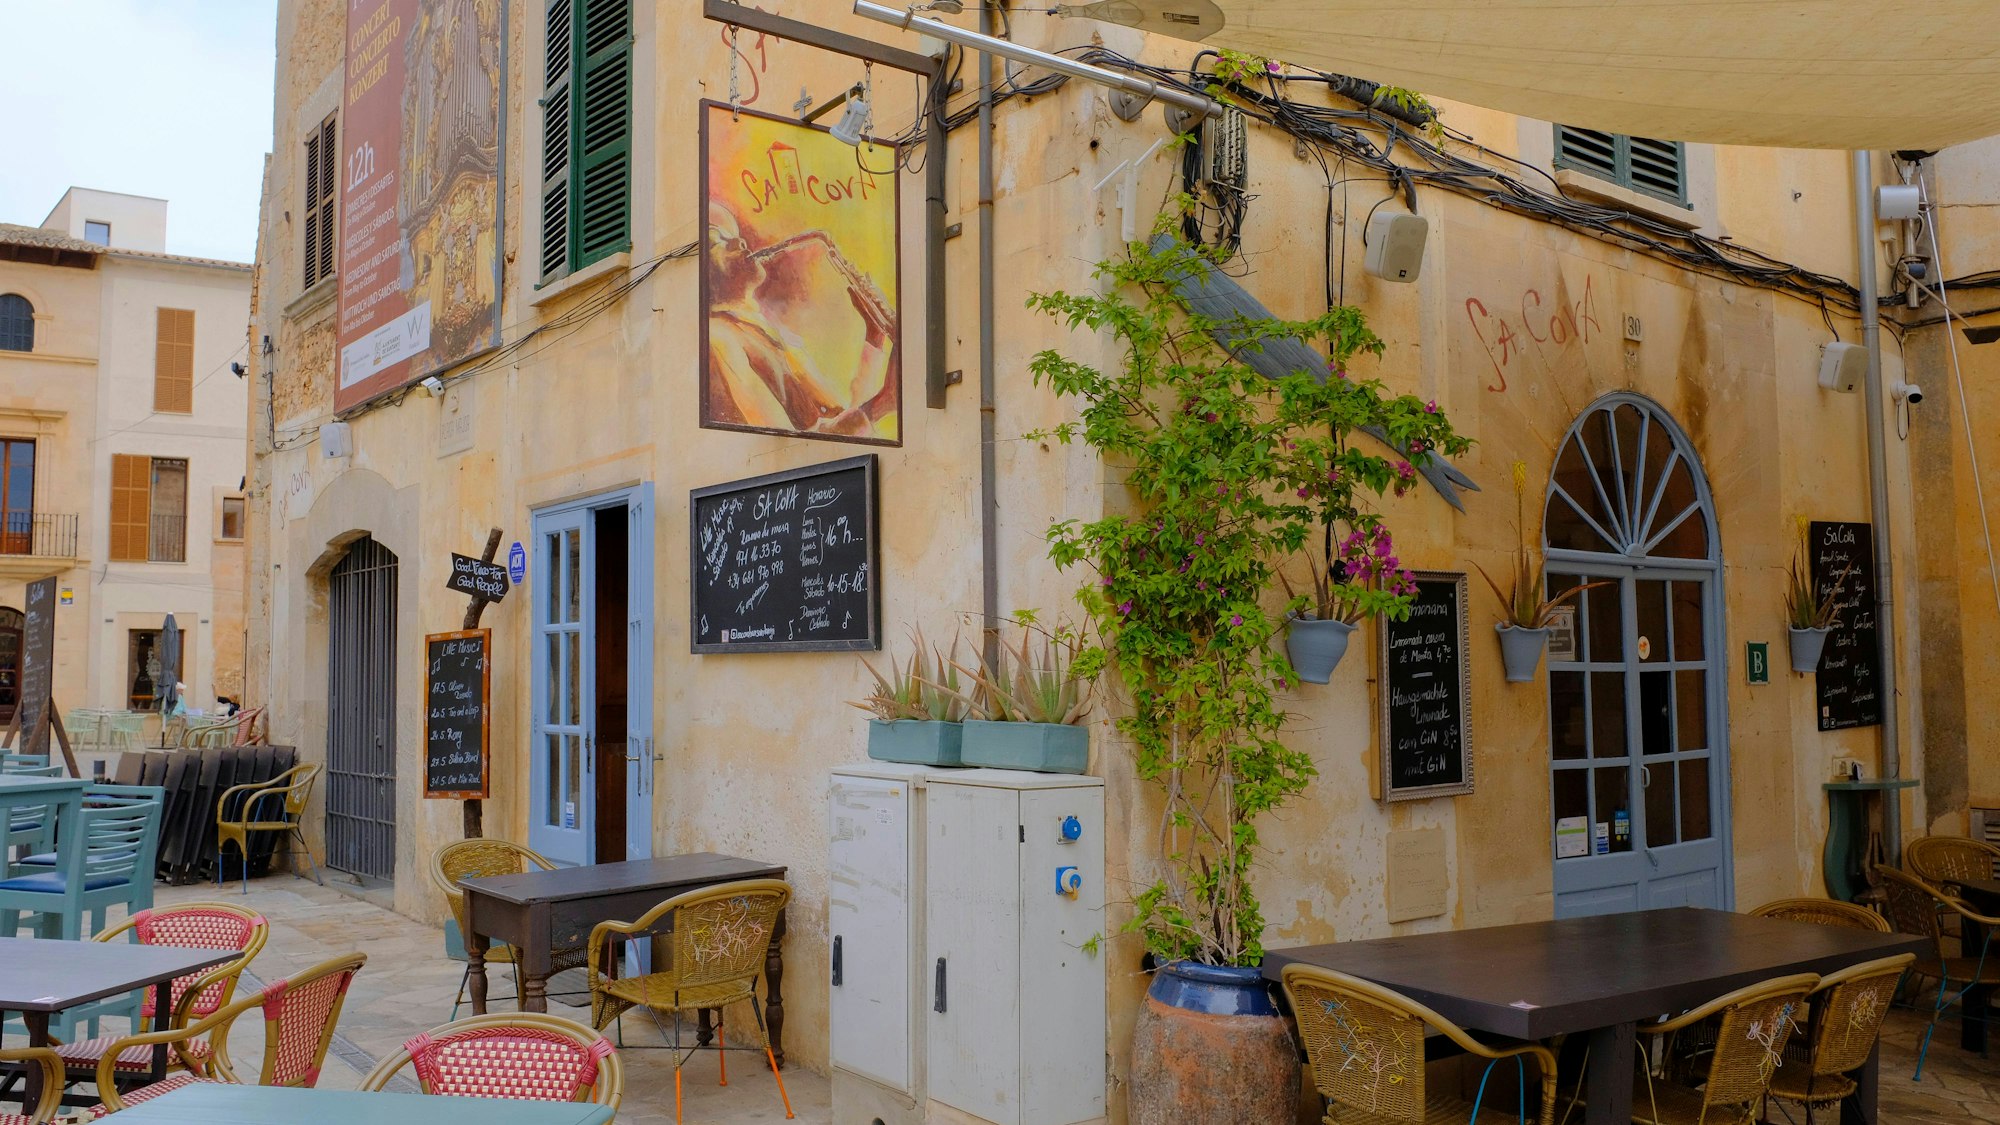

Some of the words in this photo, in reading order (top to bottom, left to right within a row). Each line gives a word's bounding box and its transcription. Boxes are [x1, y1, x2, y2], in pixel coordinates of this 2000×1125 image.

[351, 0, 389, 52] CONCERT
[350, 15, 400, 79] CONCIERTO
[349, 52, 390, 106] KONZERT
[346, 140, 374, 193] 12h
[741, 170, 778, 213] SA
[1627, 315, 1642, 337] 30
[1466, 297, 1517, 392] SA
[753, 490, 773, 521] SA
[807, 483, 836, 506] Horario
[455, 558, 473, 573] Good
[511, 553, 523, 569] ADT
[735, 547, 749, 568] 971
[759, 542, 770, 559] 33
[771, 540, 782, 557] 70
[457, 575, 475, 588] Good
[476, 576, 505, 597] People
